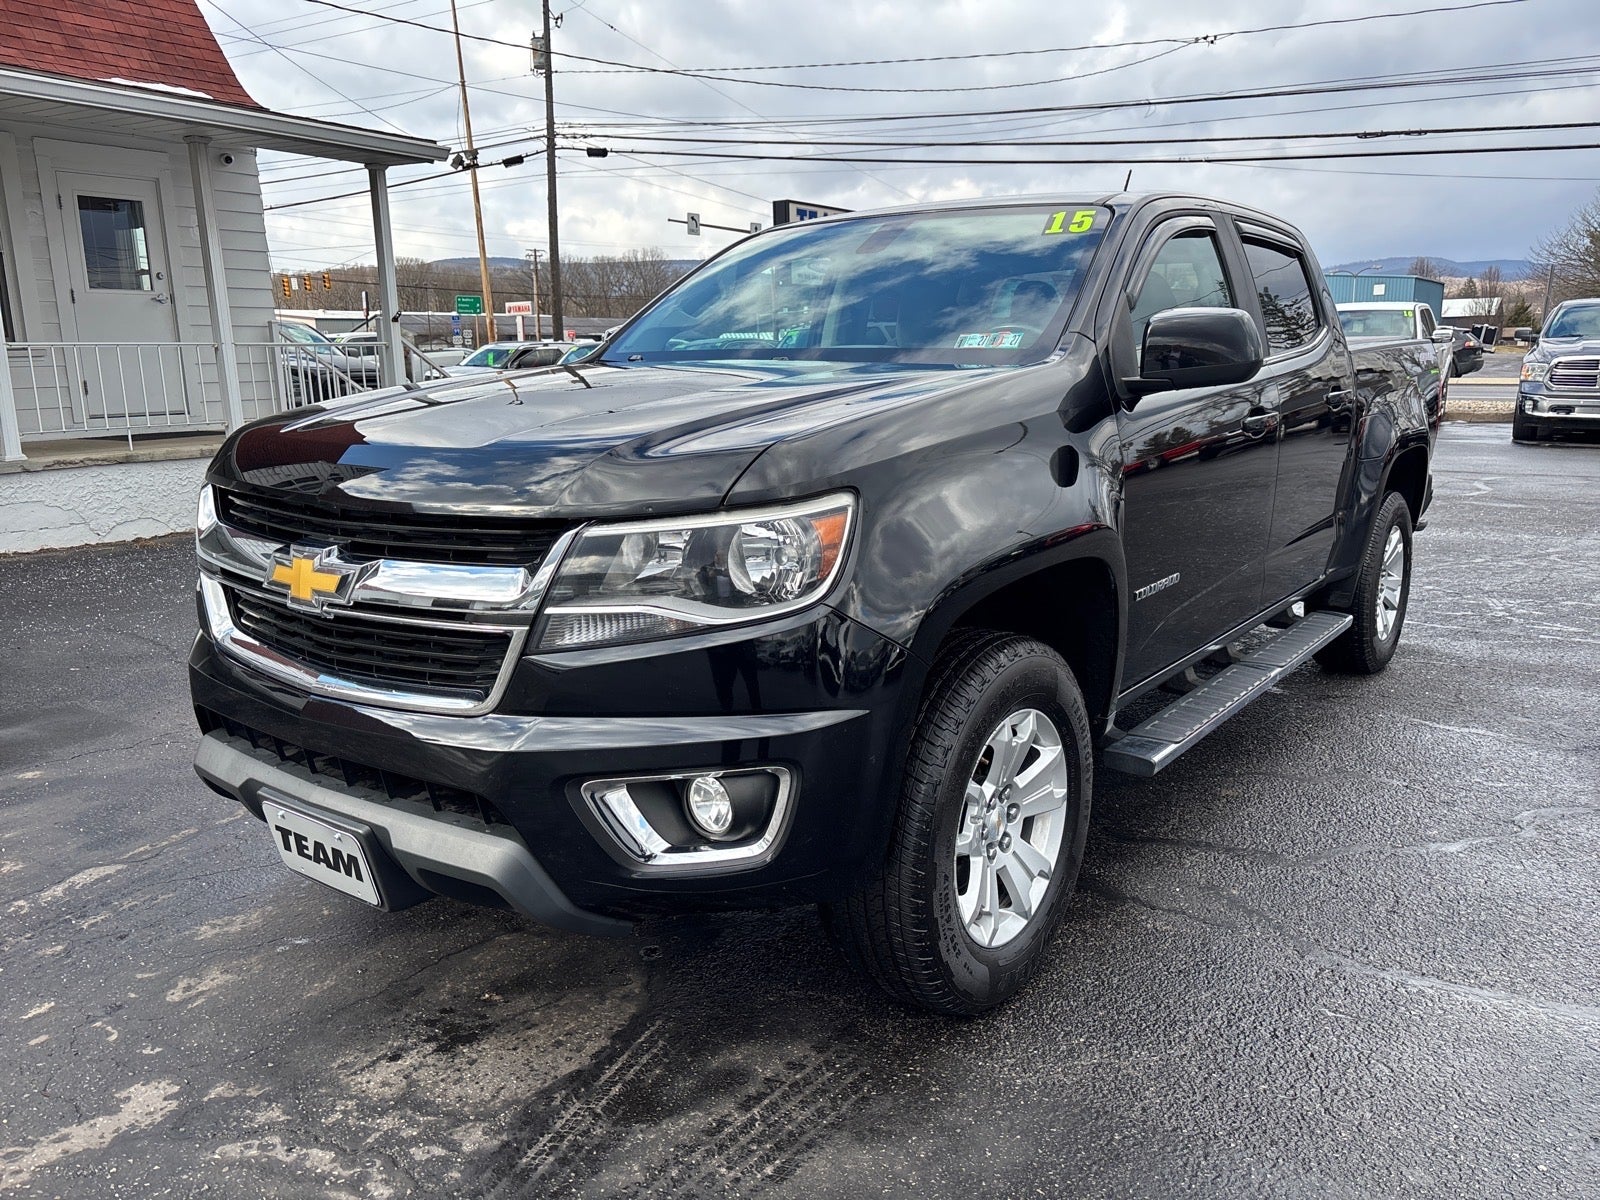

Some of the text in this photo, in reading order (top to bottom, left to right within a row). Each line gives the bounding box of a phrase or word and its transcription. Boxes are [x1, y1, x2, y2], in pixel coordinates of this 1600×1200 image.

[1045, 210, 1096, 234] 15
[512, 304, 531, 313] YAMAHA
[1134, 572, 1180, 602] COLORADO
[274, 824, 364, 883] TEAM
